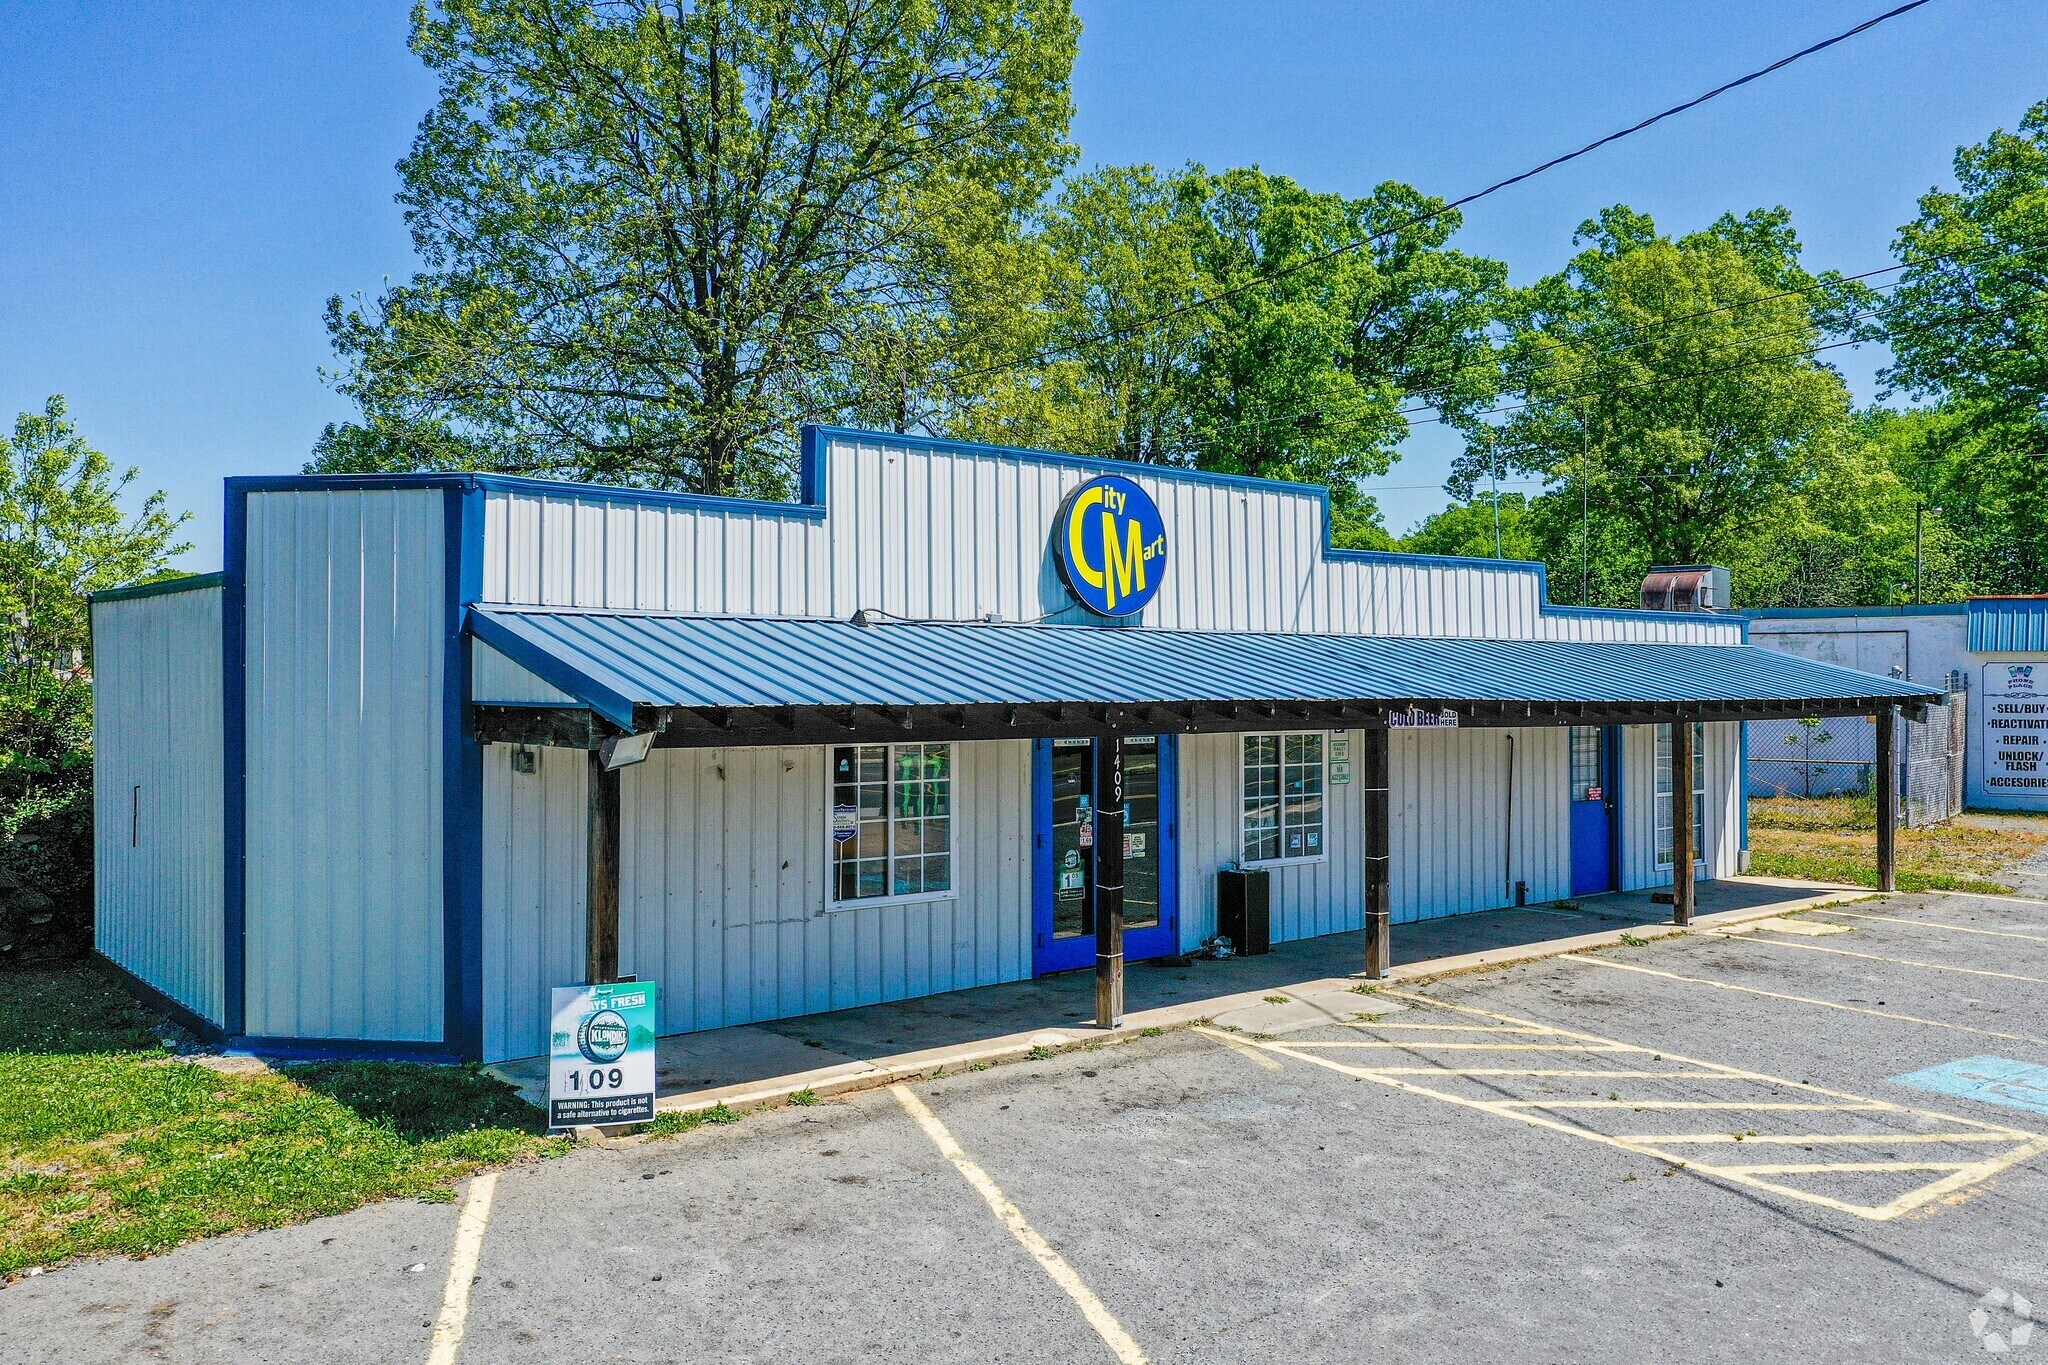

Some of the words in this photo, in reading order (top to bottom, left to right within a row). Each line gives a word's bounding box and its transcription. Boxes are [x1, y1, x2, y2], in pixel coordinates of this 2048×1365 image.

[1069, 485, 1126, 587] City
[1102, 511, 1164, 611] Mart
[1997, 704, 2045, 714] SELL/BUY
[2003, 735, 2039, 746] REPAIR
[1998, 751, 2044, 761] UNLOCK/
[1113, 738, 1122, 802] 1409
[2006, 762, 2037, 771] FLASH
[1990, 777, 2048, 787] ACCESORIE
[611, 994, 646, 1008] FRESH
[591, 1029, 627, 1043] KLONDIKE
[557, 1100, 590, 1110] WARNING:
[591, 1100, 604, 1109] This
[605, 1098, 630, 1109] product
[631, 1097, 636, 1105] is
[637, 1096, 648, 1104] not
[562, 1110, 576, 1119] safe
[577, 1109, 609, 1118] alternative
[610, 1108, 617, 1116] to
